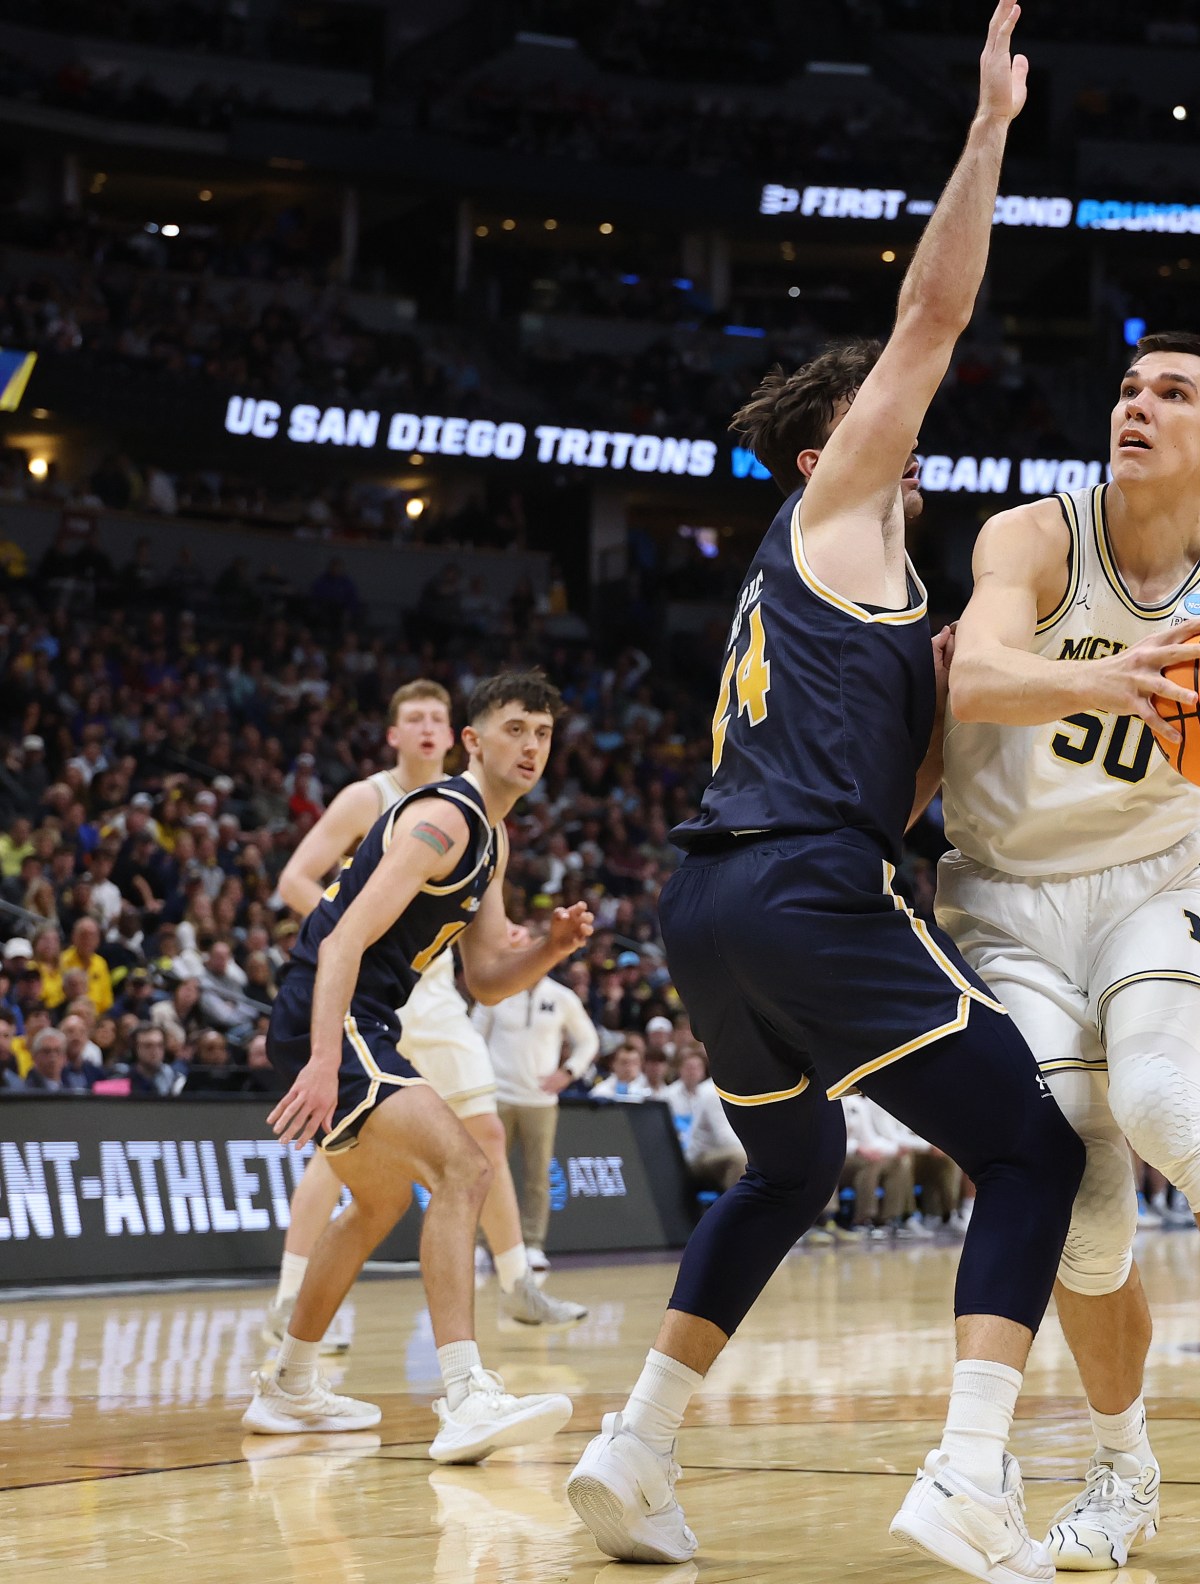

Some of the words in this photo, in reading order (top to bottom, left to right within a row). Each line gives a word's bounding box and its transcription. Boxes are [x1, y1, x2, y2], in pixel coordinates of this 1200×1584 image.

[801, 186, 907, 220] FIRST
[225, 395, 281, 439] UC
[288, 404, 380, 448] SAN
[387, 413, 527, 460] DIEGO
[535, 425, 717, 477] TRITONS
[1050, 707, 1156, 786] 50
[567, 1156, 627, 1198] AT&T
